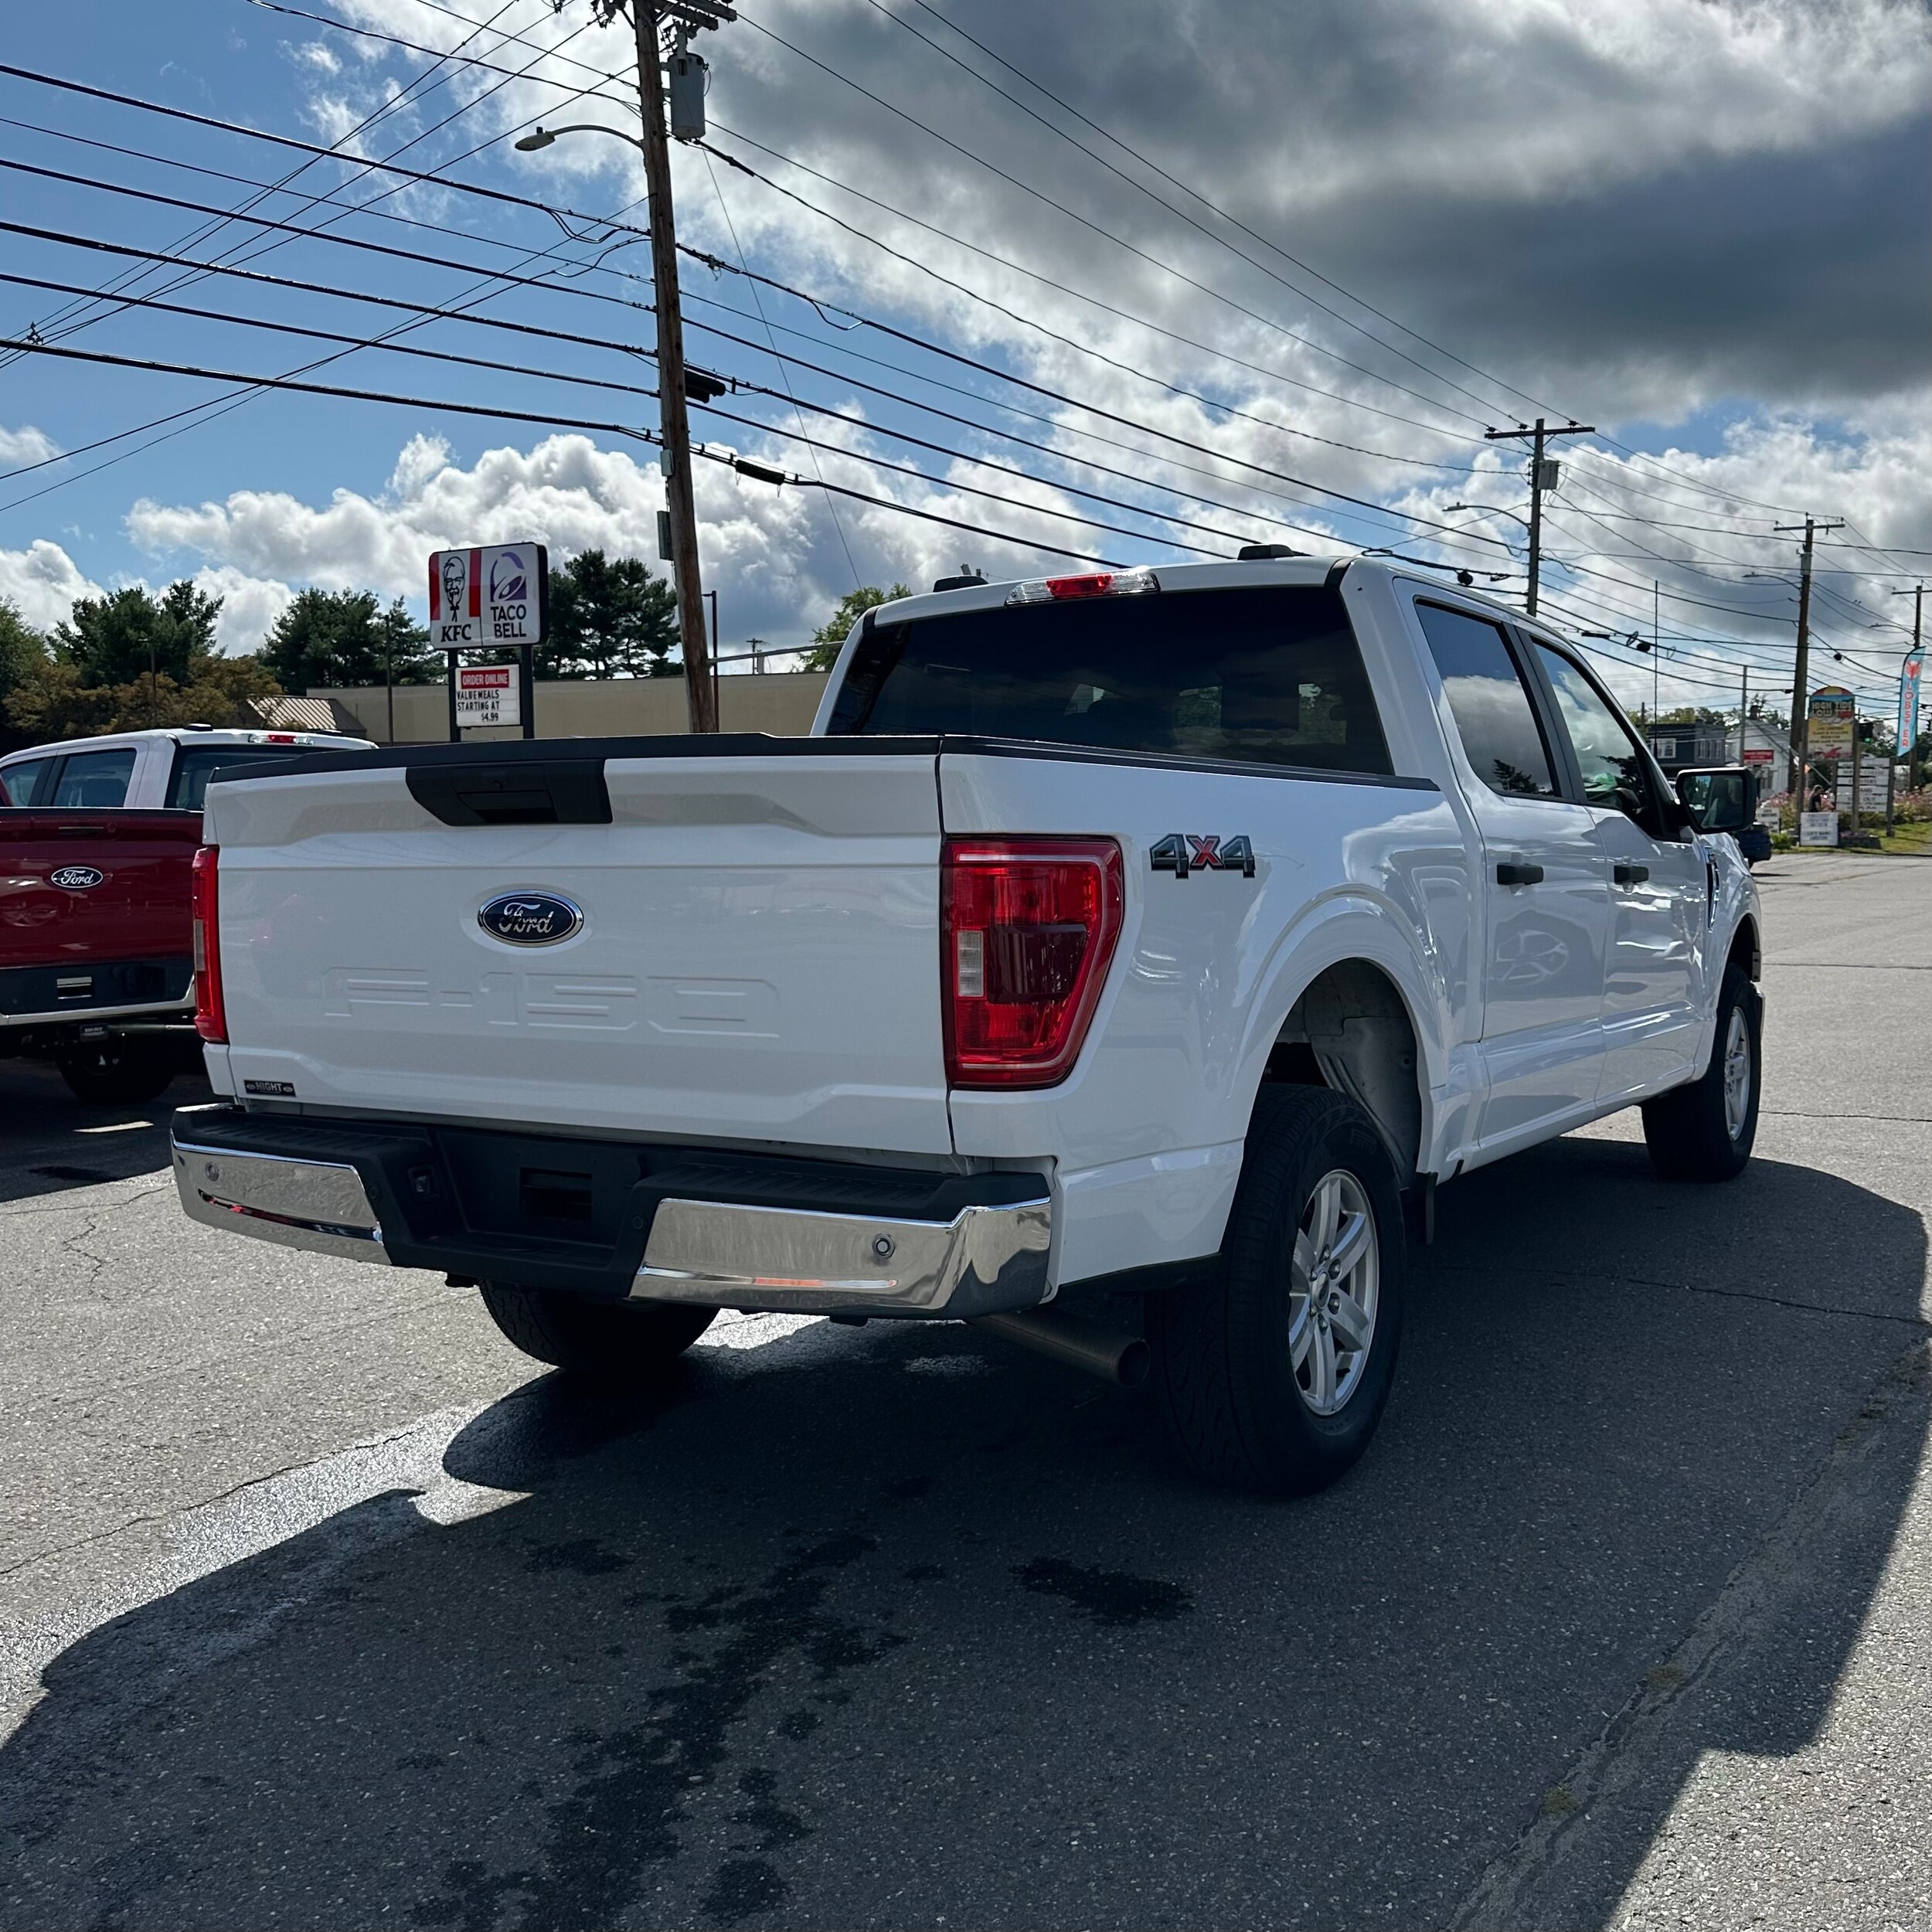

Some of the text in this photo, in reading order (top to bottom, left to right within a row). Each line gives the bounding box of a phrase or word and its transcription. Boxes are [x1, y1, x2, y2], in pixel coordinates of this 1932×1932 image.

[491, 604, 526, 621] TACO
[441, 624, 471, 642] KFC
[494, 622, 526, 638] BELL
[462, 673, 508, 685] ORDER ONLINE
[457, 689, 500, 700] VALUE MEALS
[457, 701, 500, 711] STARTING AT
[1835, 701, 1852, 709] TIDE
[481, 713, 499, 722] $4.99
[1902, 682, 1914, 747] LOBSTER
[61, 869, 94, 884] Ford
[498, 902, 554, 933] Ford
[322, 966, 780, 1037] F-150
[255, 1081, 282, 1092] HIGHT
